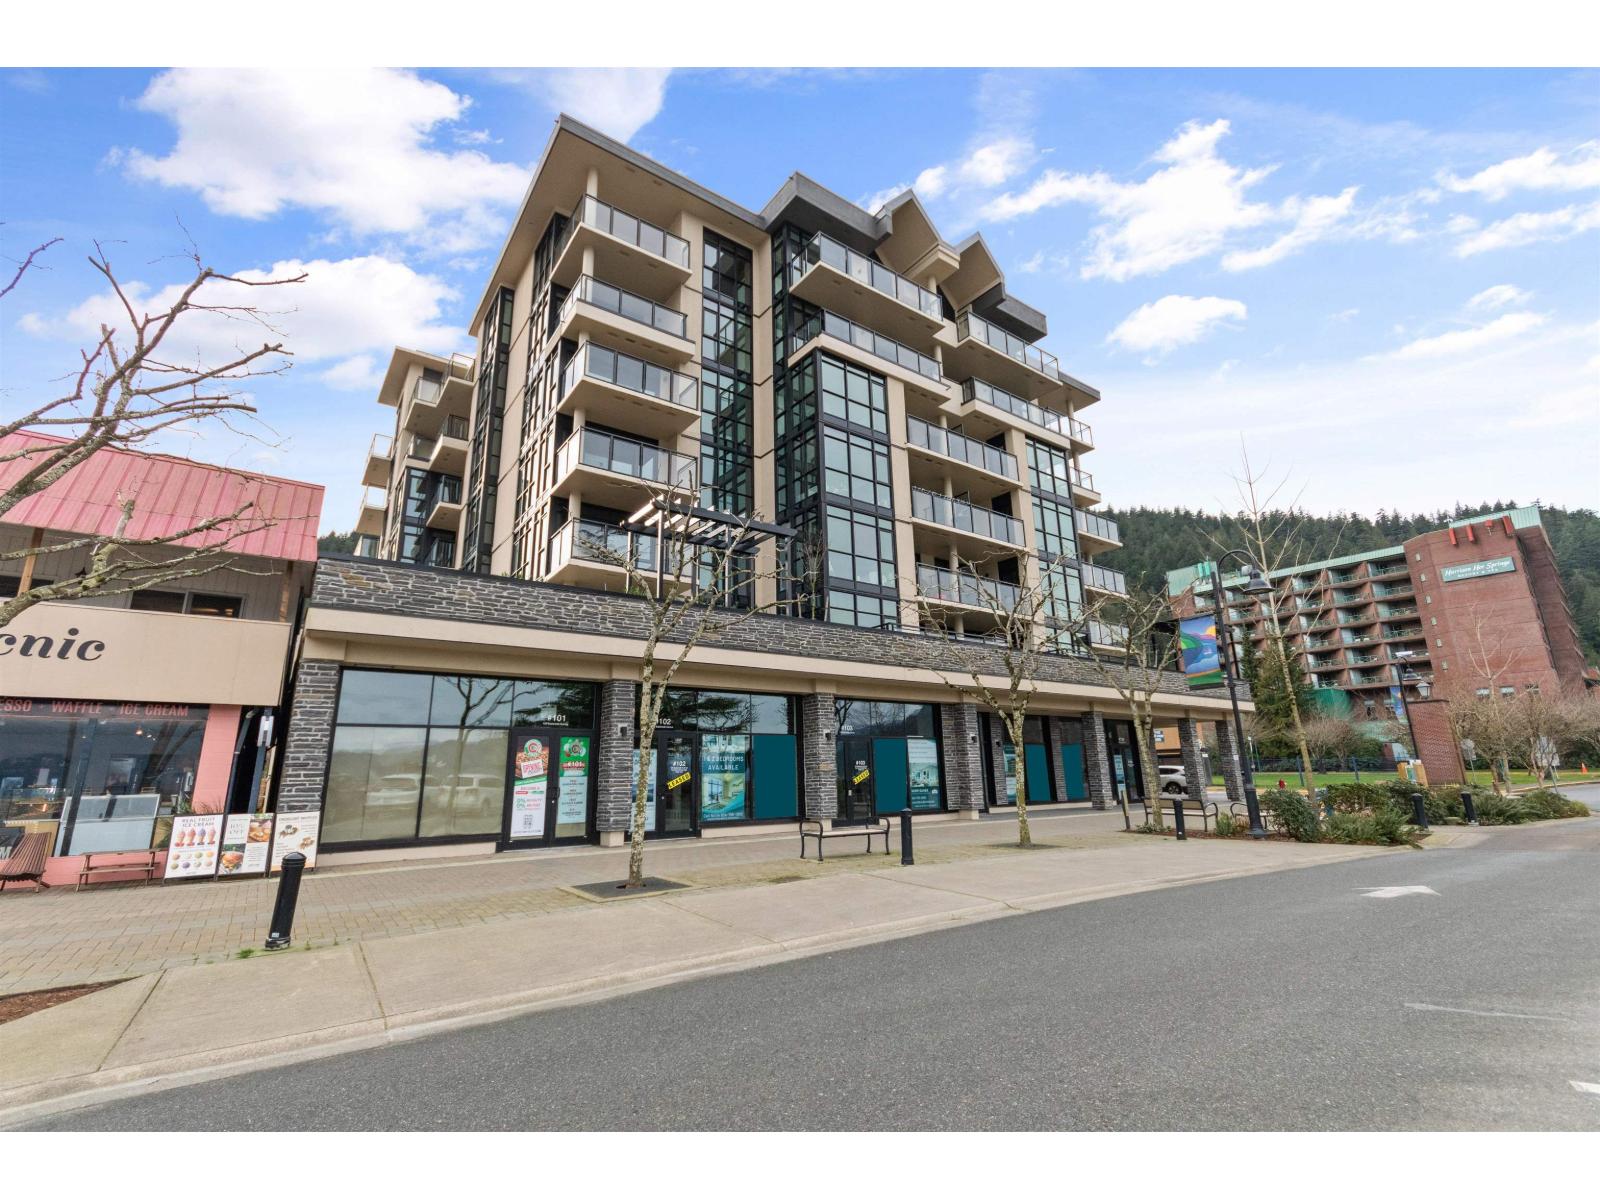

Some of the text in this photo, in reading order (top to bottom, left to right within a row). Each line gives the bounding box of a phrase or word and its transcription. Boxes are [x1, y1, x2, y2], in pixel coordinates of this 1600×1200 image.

[52, 701, 102, 714] WAFFLE
[119, 703, 139, 716] ICE
[144, 704, 189, 717] CREAM
[656, 718, 672, 726] 102
